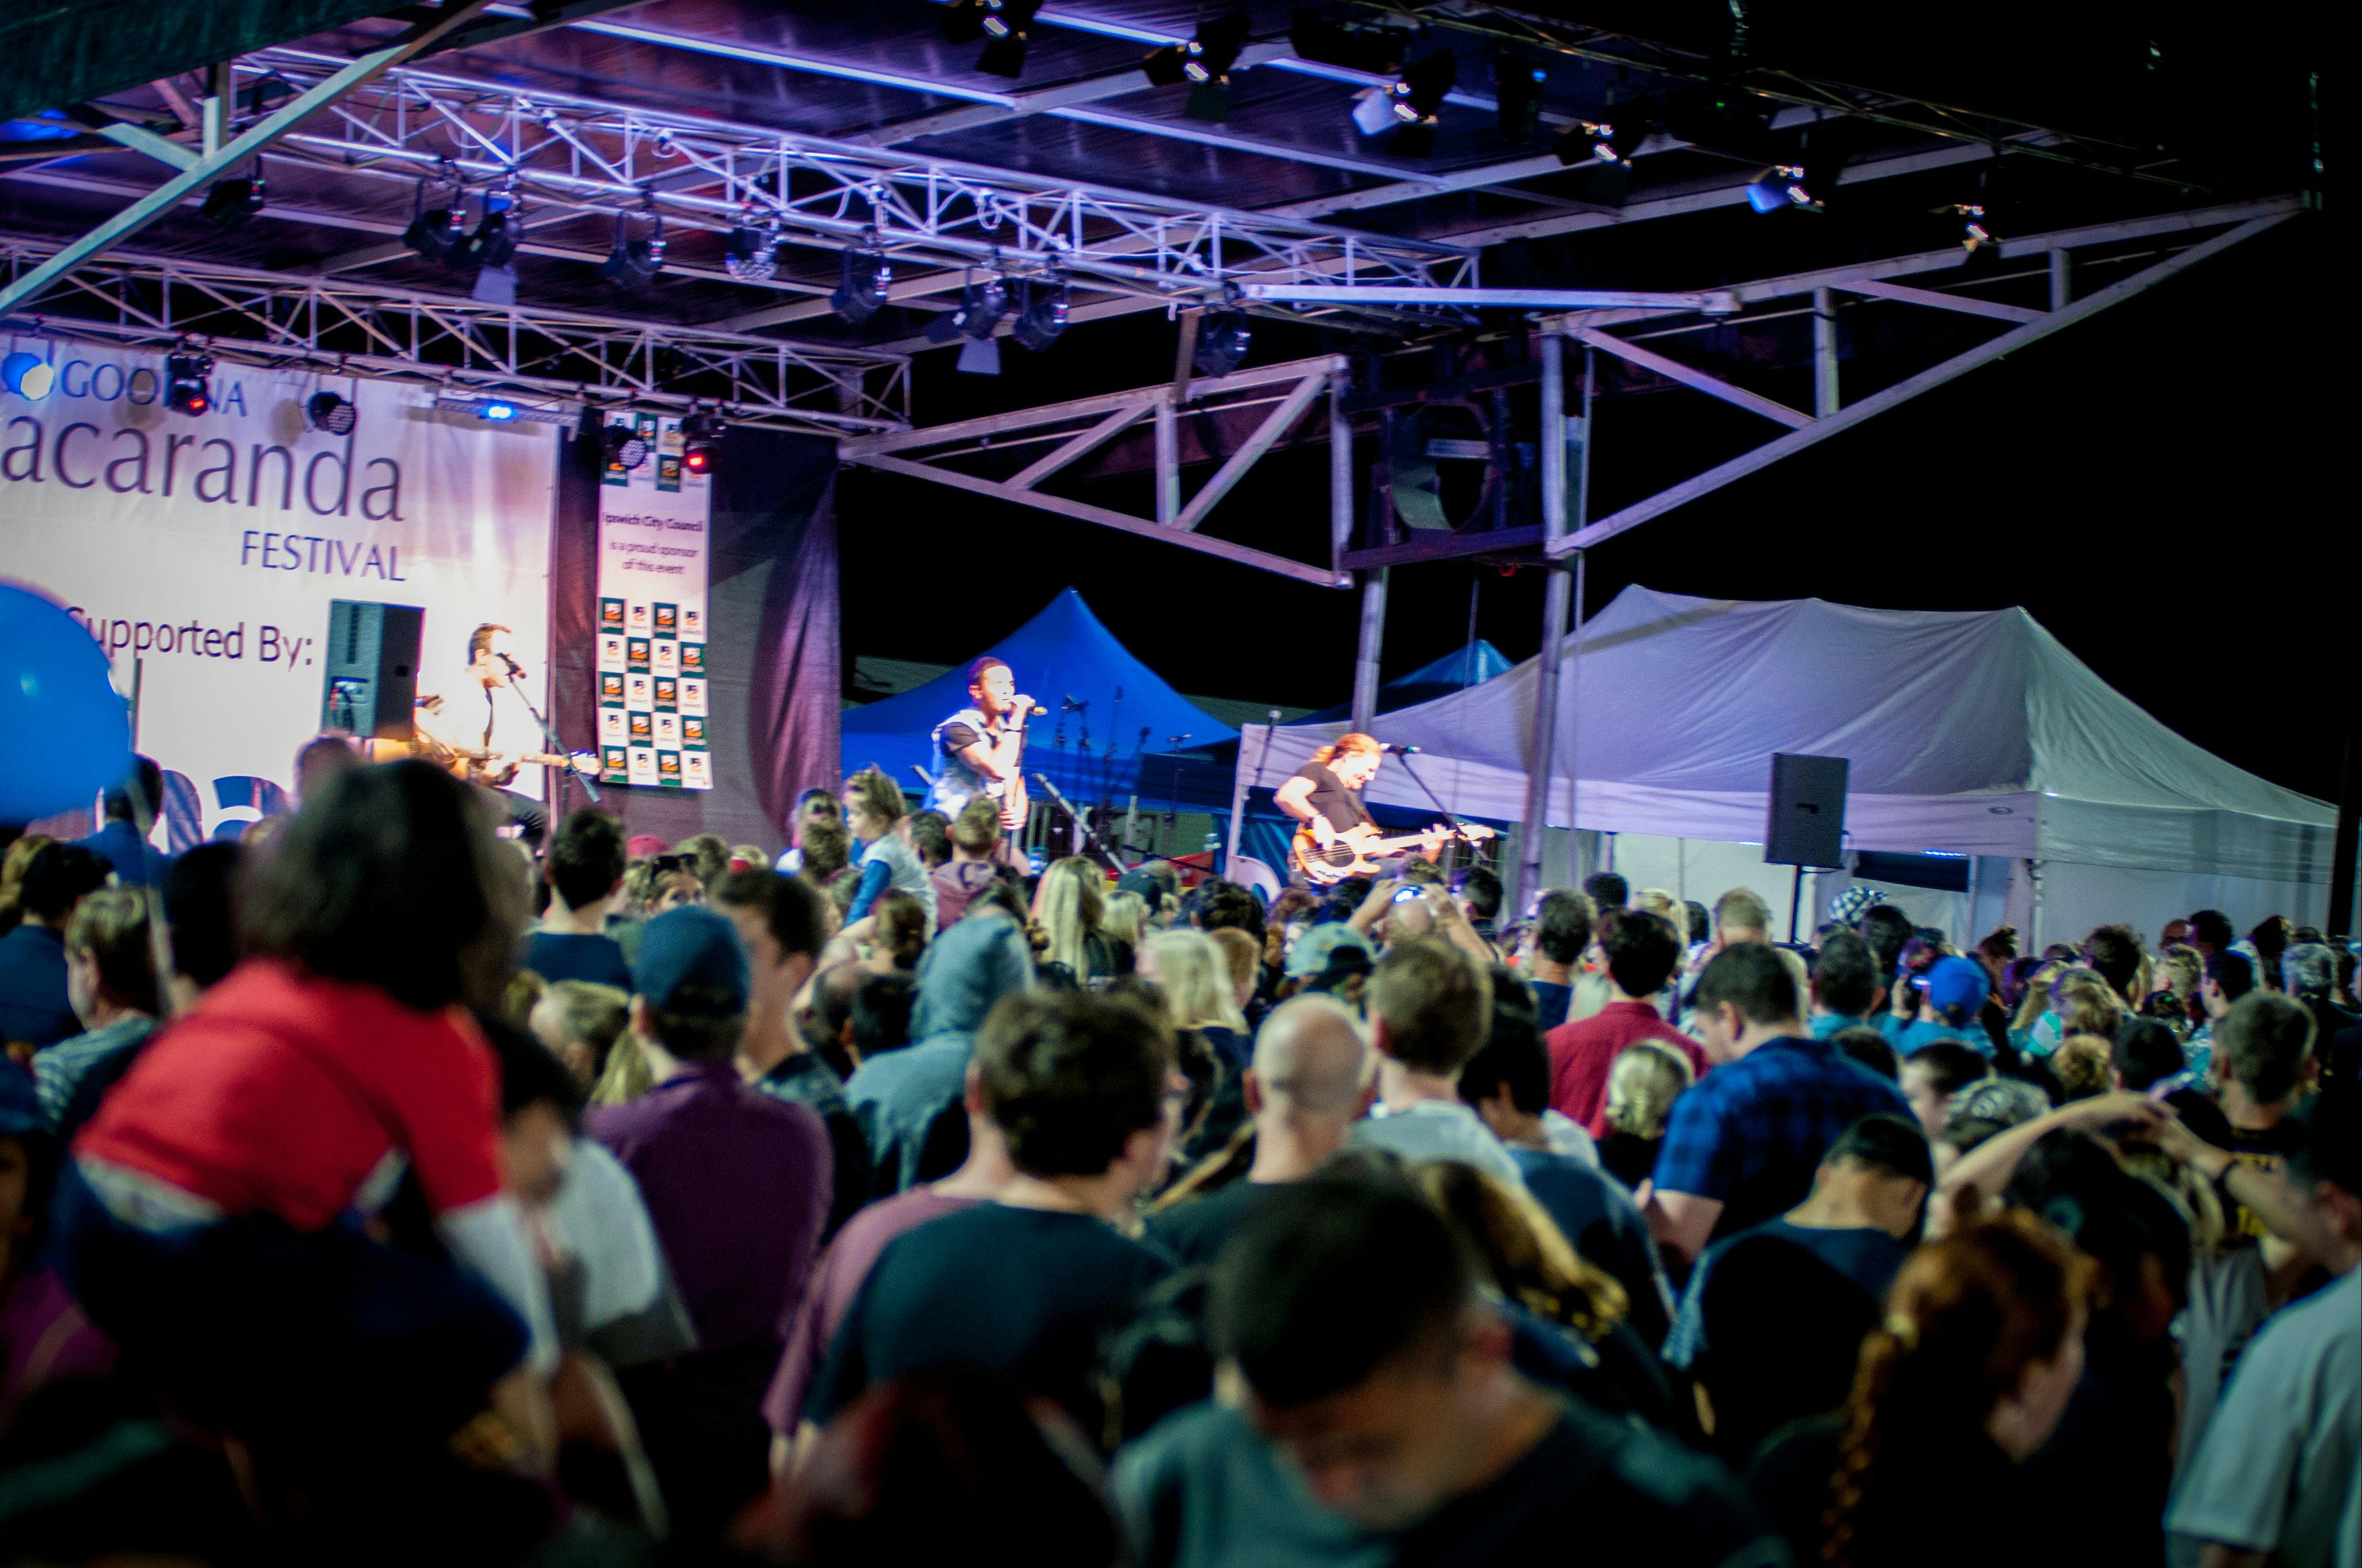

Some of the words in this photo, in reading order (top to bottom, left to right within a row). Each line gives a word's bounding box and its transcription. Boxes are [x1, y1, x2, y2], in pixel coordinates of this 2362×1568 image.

[61, 360, 248, 417] GOONA
[643, 515, 664, 531] City
[665, 518, 704, 532] Council
[241, 531, 407, 582] FESTIVAL
[66, 606, 245, 659] upported
[259, 625, 313, 672] By:
